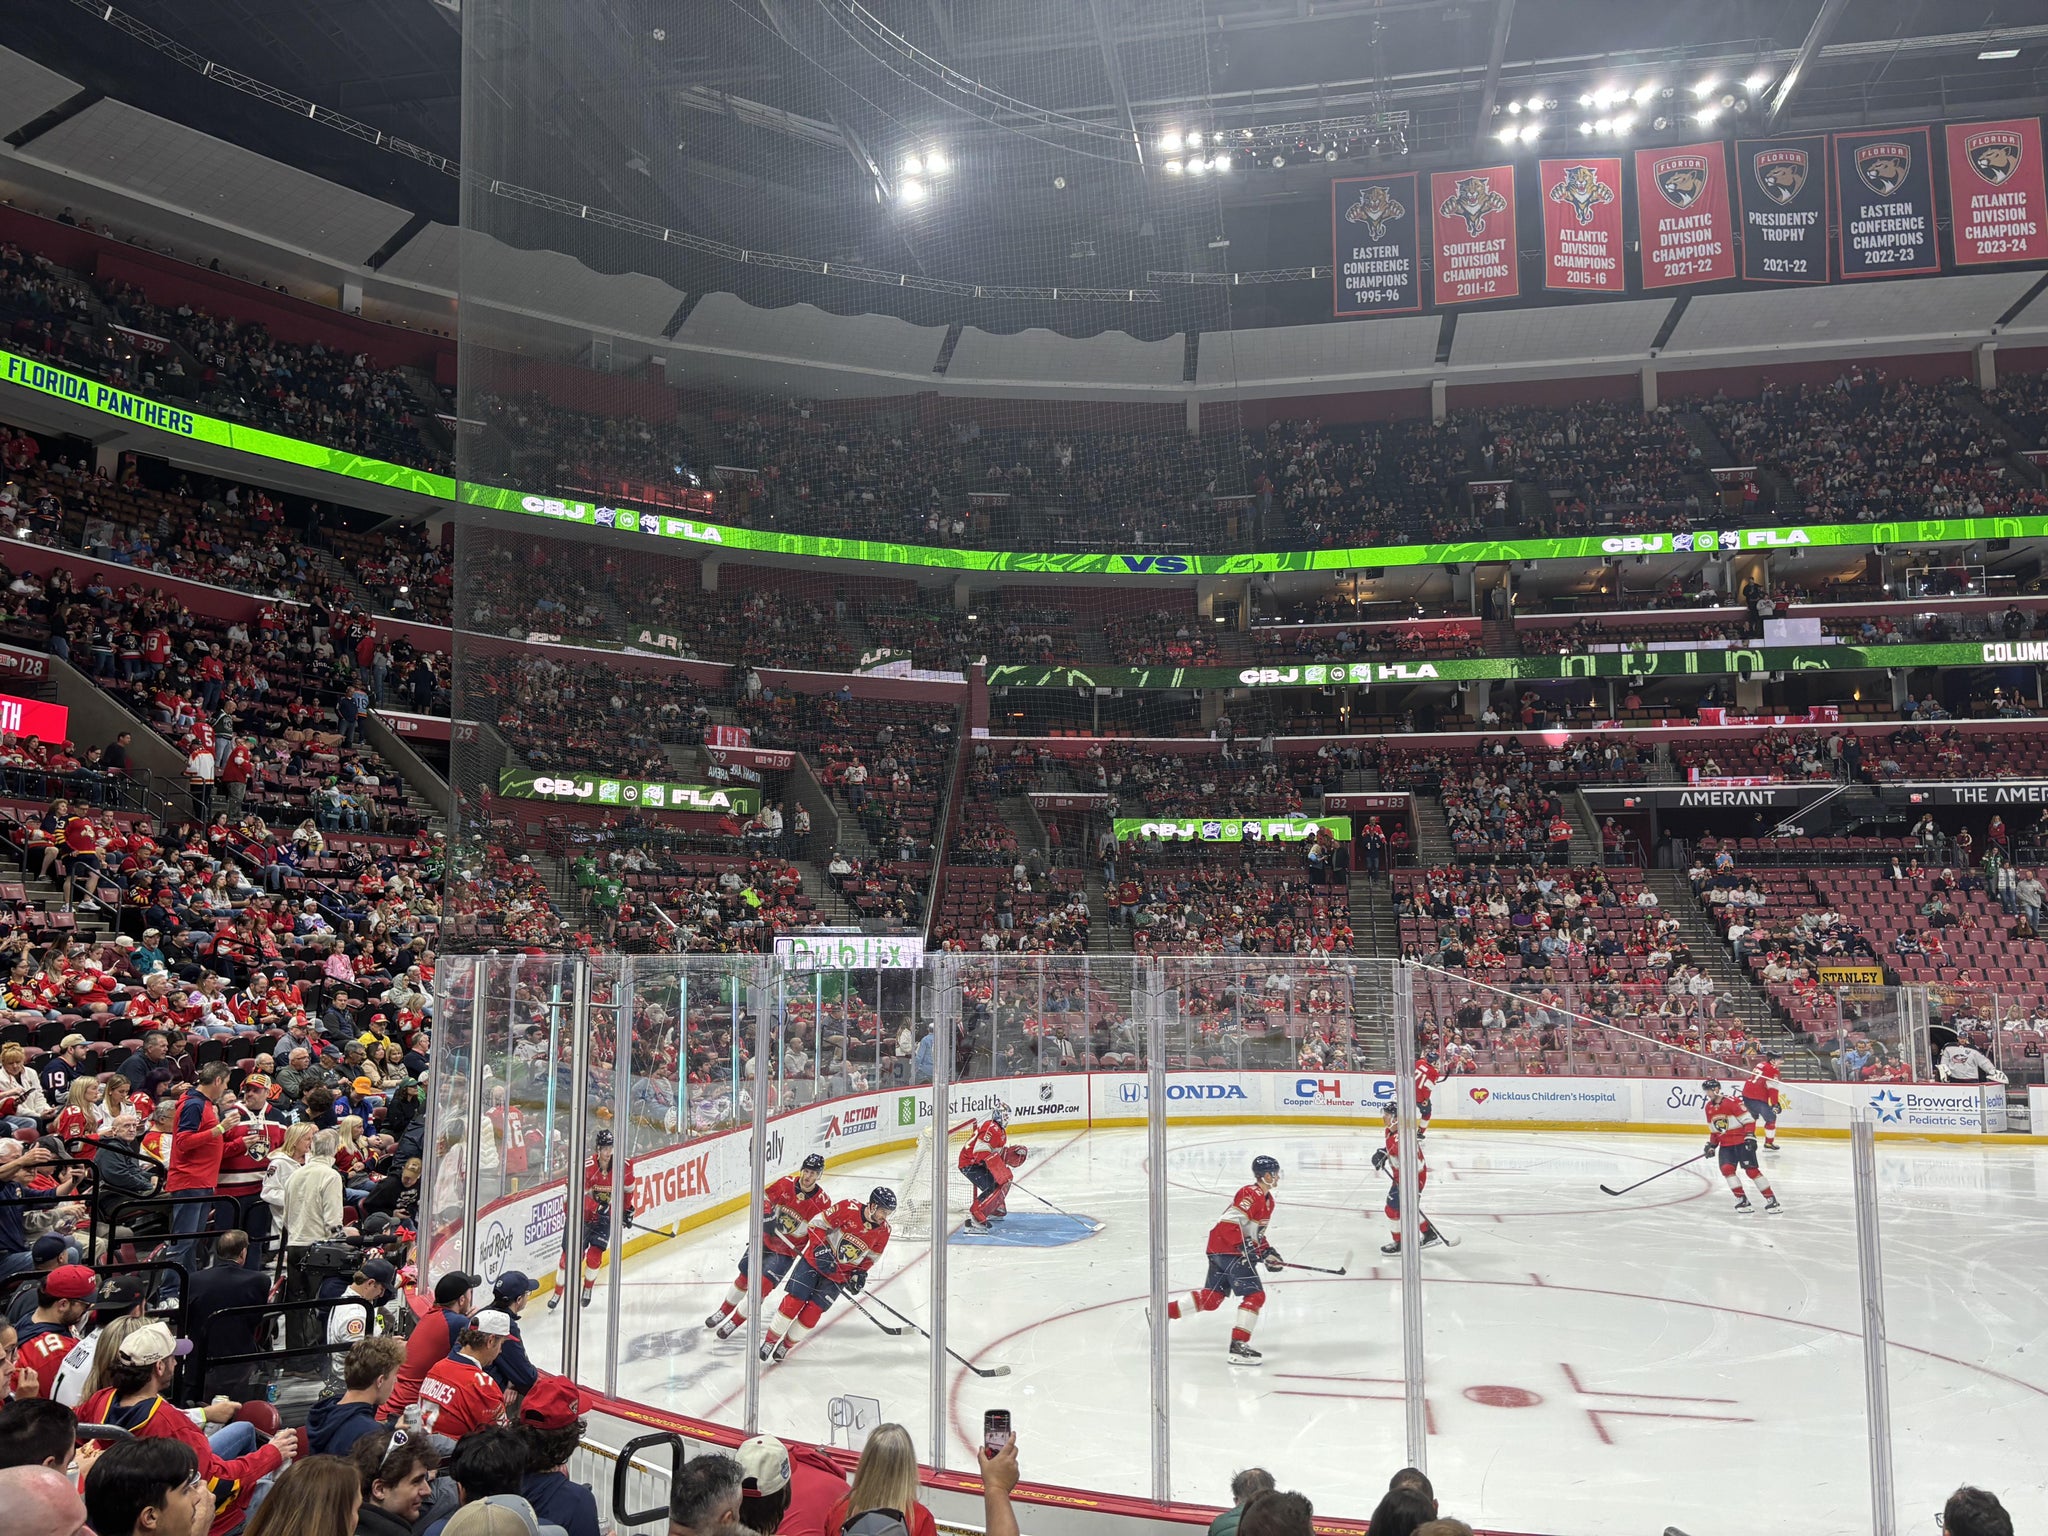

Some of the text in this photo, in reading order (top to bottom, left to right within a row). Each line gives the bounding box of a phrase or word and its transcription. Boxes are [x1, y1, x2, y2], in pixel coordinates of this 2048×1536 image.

[1973, 135, 2015, 147] FLORIDA
[1761, 153, 1801, 164] FLORIDA
[1862, 146, 1904, 158] FLORIDA
[1660, 159, 1701, 172] FLORIDA
[1971, 192, 2027, 208] ATLANTIC
[1749, 211, 1819, 226] PRESIDENTS'
[1860, 202, 1913, 219] EASTERN
[1973, 207, 2026, 224] DIVISION
[1658, 213, 1712, 232] ATLANTIC
[1850, 216, 1925, 235] CONFERENCE
[1965, 222, 2037, 239] CHAMPIONS
[1559, 229, 1608, 242] ATLANTIC
[1660, 228, 1712, 247] DIVISION
[1762, 228, 1805, 242] TROPHY
[1853, 232, 1924, 250] CHAMPIONS
[1352, 245, 1399, 260] EASTERN
[1443, 238, 1507, 256] SOUTHEAST
[1561, 242, 1607, 256] DIVISION
[1652, 242, 1722, 263] CHAMPIONS
[1977, 238, 2027, 255] 2023-24
[1451, 252, 1499, 269] DIVISION
[1554, 255, 1616, 270] CHAMPIONS
[1865, 248, 1915, 264] 2022-23
[1343, 259, 1410, 275] CONFERENCE
[1664, 259, 1713, 278] 2021-22
[1763, 258, 1807, 273] 2021-22
[1345, 274, 1408, 289] CHAMPIONS
[1443, 265, 1509, 283] CHAMPIONS
[1566, 271, 1607, 284] 2015-16
[1355, 289, 1400, 303] 1995-96
[1456, 280, 1496, 296] 2011-12
[142, 337, 164, 352] 329
[8, 357, 193, 434] FLORIDA PANTHERS
[521, 496, 585, 519] CBJ
[666, 520, 722, 542] FLA
[1601, 536, 1663, 553] CBJ
[1747, 529, 1811, 546] FLA
[1121, 555, 1188, 573] VS
[146, 637, 158, 651] 19
[20, 656, 43, 677] 128
[1239, 668, 1298, 685] CBJ
[1378, 664, 1439, 680] FLA
[2, 700, 22, 731] TH
[773, 755, 791, 767] 130
[533, 777, 594, 798] CBJ
[671, 789, 731, 808] FLA
[1680, 791, 1776, 806] AMERANT
[1952, 788, 1988, 803] THE
[1330, 798, 1405, 809] 132 133
[1141, 823, 1195, 836] CBJ
[1269, 823, 1322, 836] FLA
[789, 939, 902, 967] Publix
[1822, 972, 1878, 984] STANLEY
[48, 1071, 65, 1088] 19
[1283, 1098, 1314, 1107] Cooper
[1326, 1098, 1355, 1107] Hunter
[1492, 1091, 1616, 1103] Nicklaus Children's Hospital
[1907, 1094, 1972, 1107] Broward
[66, 1106, 81, 1116] 13
[843, 1105, 878, 1124] ACTION
[919, 1099, 958, 1117] Bast
[843, 1121, 877, 1136] ROOFING
[1909, 1115, 1957, 1126] Pediatric
[533, 1200, 564, 1223] FLORIDA
[494, 1227, 514, 1258] Rock
[322, 1253, 331, 1265] 3
[489, 1261, 499, 1275] BET
[34, 1333, 64, 1358] 19
